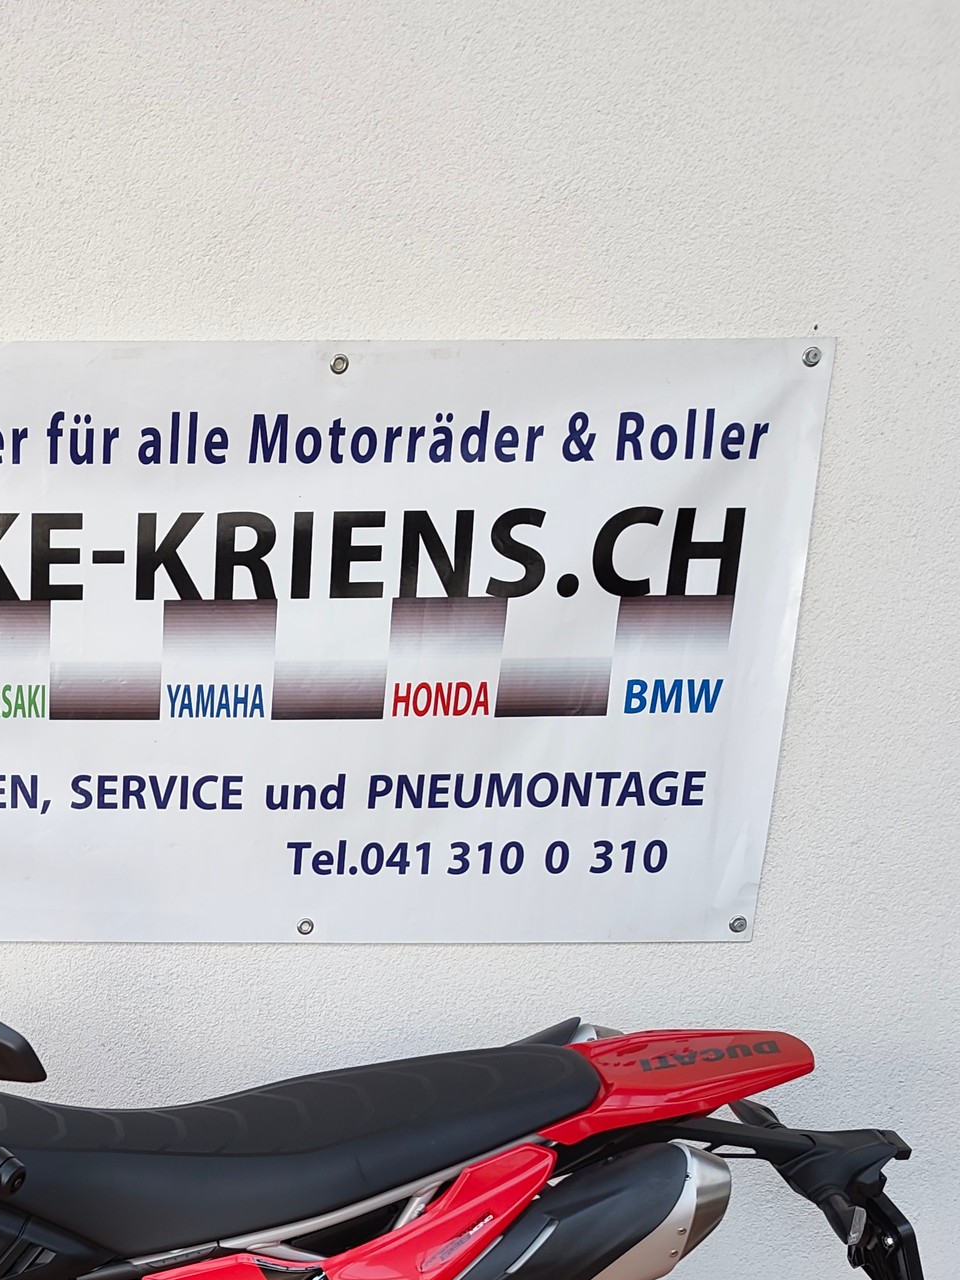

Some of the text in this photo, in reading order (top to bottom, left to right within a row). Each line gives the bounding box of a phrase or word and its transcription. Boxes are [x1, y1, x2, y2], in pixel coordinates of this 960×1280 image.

[46, 410, 120, 466] für
[136, 411, 229, 466] alle
[248, 410, 545, 465] Motorräder
[562, 411, 597, 463] &
[615, 408, 770, 462] Roller
[166, 683, 265, 719] YAMAHA
[392, 681, 490, 718] HONDA
[623, 678, 724, 715] BMW
[70, 774, 244, 811] SERVICE
[265, 774, 346, 811] und
[367, 770, 707, 810] PNEUMONTAGE
[286, 839, 668, 876] Tel.041 310 0 310
[640, 1040, 781, 1072] DUCATI
